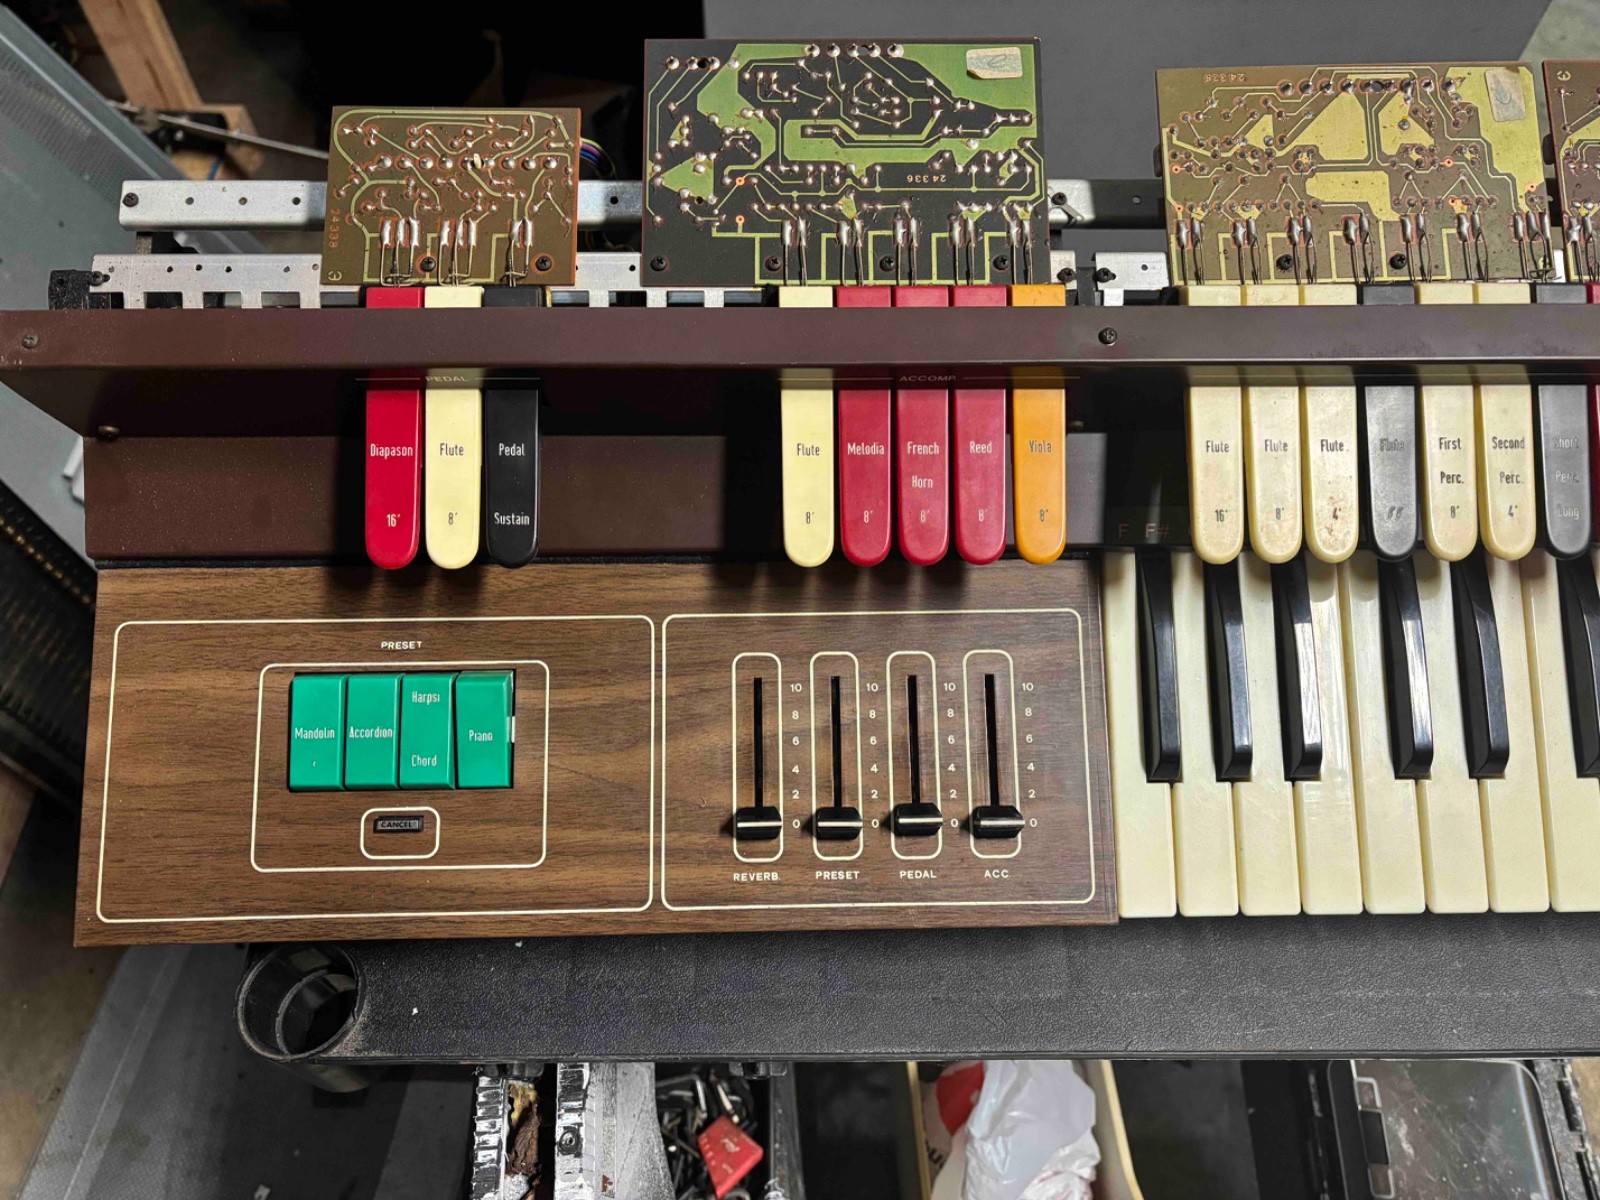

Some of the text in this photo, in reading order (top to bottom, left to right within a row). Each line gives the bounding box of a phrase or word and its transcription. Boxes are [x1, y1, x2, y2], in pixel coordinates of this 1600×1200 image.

[970, 441, 992, 454] Reed
[1029, 440, 1052, 453] Viola
[1206, 440, 1229, 453] Flute
[1264, 439, 1288, 452] Flute
[1320, 439, 1344, 452] Flute
[1438, 437, 1461, 450] First
[1492, 436, 1525, 450] Second
[370, 443, 413, 459] Diapason
[440, 443, 464, 456] Flute
[499, 443, 525, 456] Pedal
[797, 443, 820, 456] Flute
[847, 442, 885, 455] Melodia
[907, 441, 939, 455] French
[912, 475, 933, 488] Horn
[1440, 471, 1464, 484] Perc.
[494, 512, 530, 525] Sustain
[1119, 523, 1129, 538] F
[381, 641, 422, 650] PRESET
[790, 683, 802, 692] 10
[866, 683, 879, 692] 10
[944, 683, 956, 691] 10
[1022, 682, 1034, 691] 10
[412, 691, 440, 705] Harpsi
[792, 711, 799, 719] 8
[869, 710, 876, 718] 8
[947, 709, 954, 717] 8
[1025, 708, 1032, 716] 8
[295, 727, 335, 739] Mandolin
[349, 726, 393, 738] Accordion
[468, 730, 493, 741] Piano
[792, 736, 799, 745] 6
[870, 736, 877, 745] 6
[948, 735, 955, 744] 6
[1026, 734, 1033, 743] 6
[411, 754, 437, 767] Chord
[792, 765, 799, 773] 4
[870, 764, 878, 773] 4
[948, 763, 956, 772] 4
[1027, 762, 1035, 771] 4
[792, 790, 799, 799] 2
[871, 790, 878, 799] 2
[950, 789, 957, 798] 2
[1028, 789, 1035, 798] 2
[792, 819, 800, 828] 0
[872, 819, 879, 828] 0
[951, 819, 958, 827] 0
[1030, 819, 1037, 827] 0
[815, 871, 860, 880] PRESET
[900, 870, 937, 879] PEDAL
